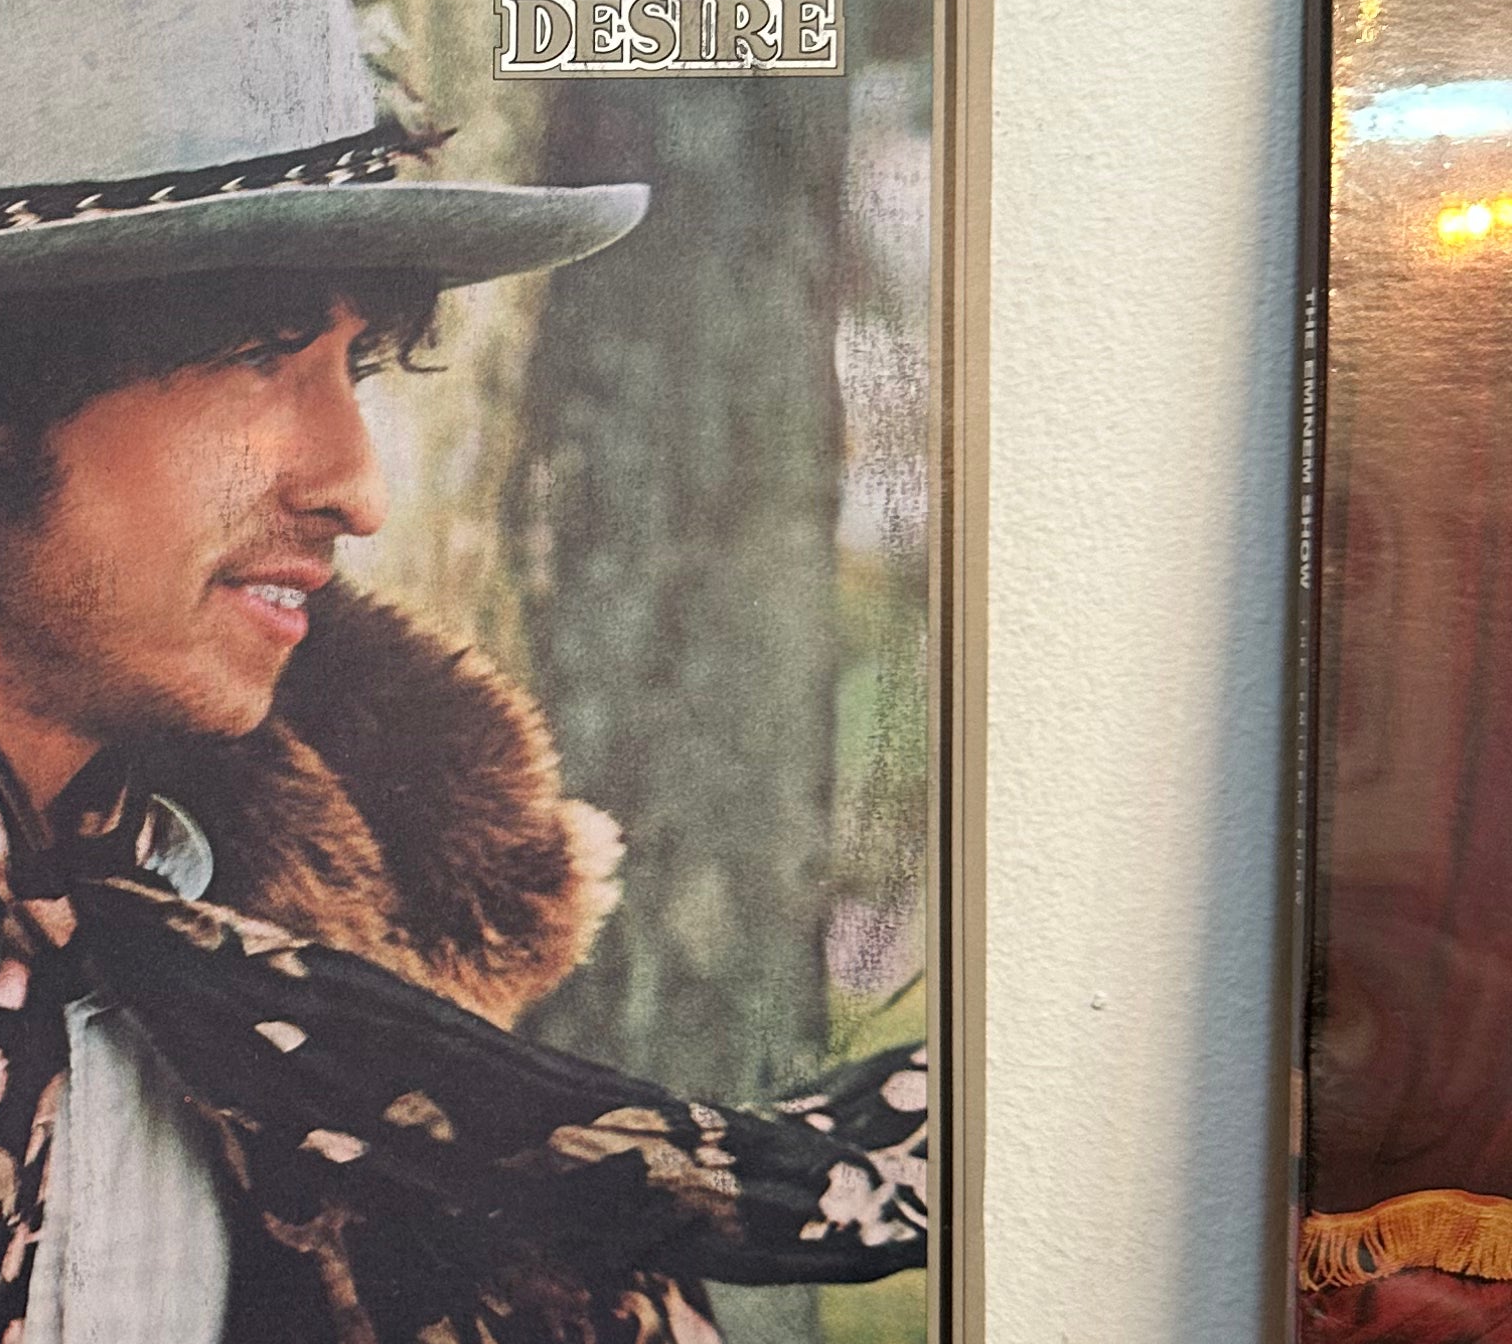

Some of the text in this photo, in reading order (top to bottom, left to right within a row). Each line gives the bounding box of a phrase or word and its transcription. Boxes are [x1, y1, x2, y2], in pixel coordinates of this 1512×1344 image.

[1299, 287, 1318, 590] THE EMINEM SHOW
